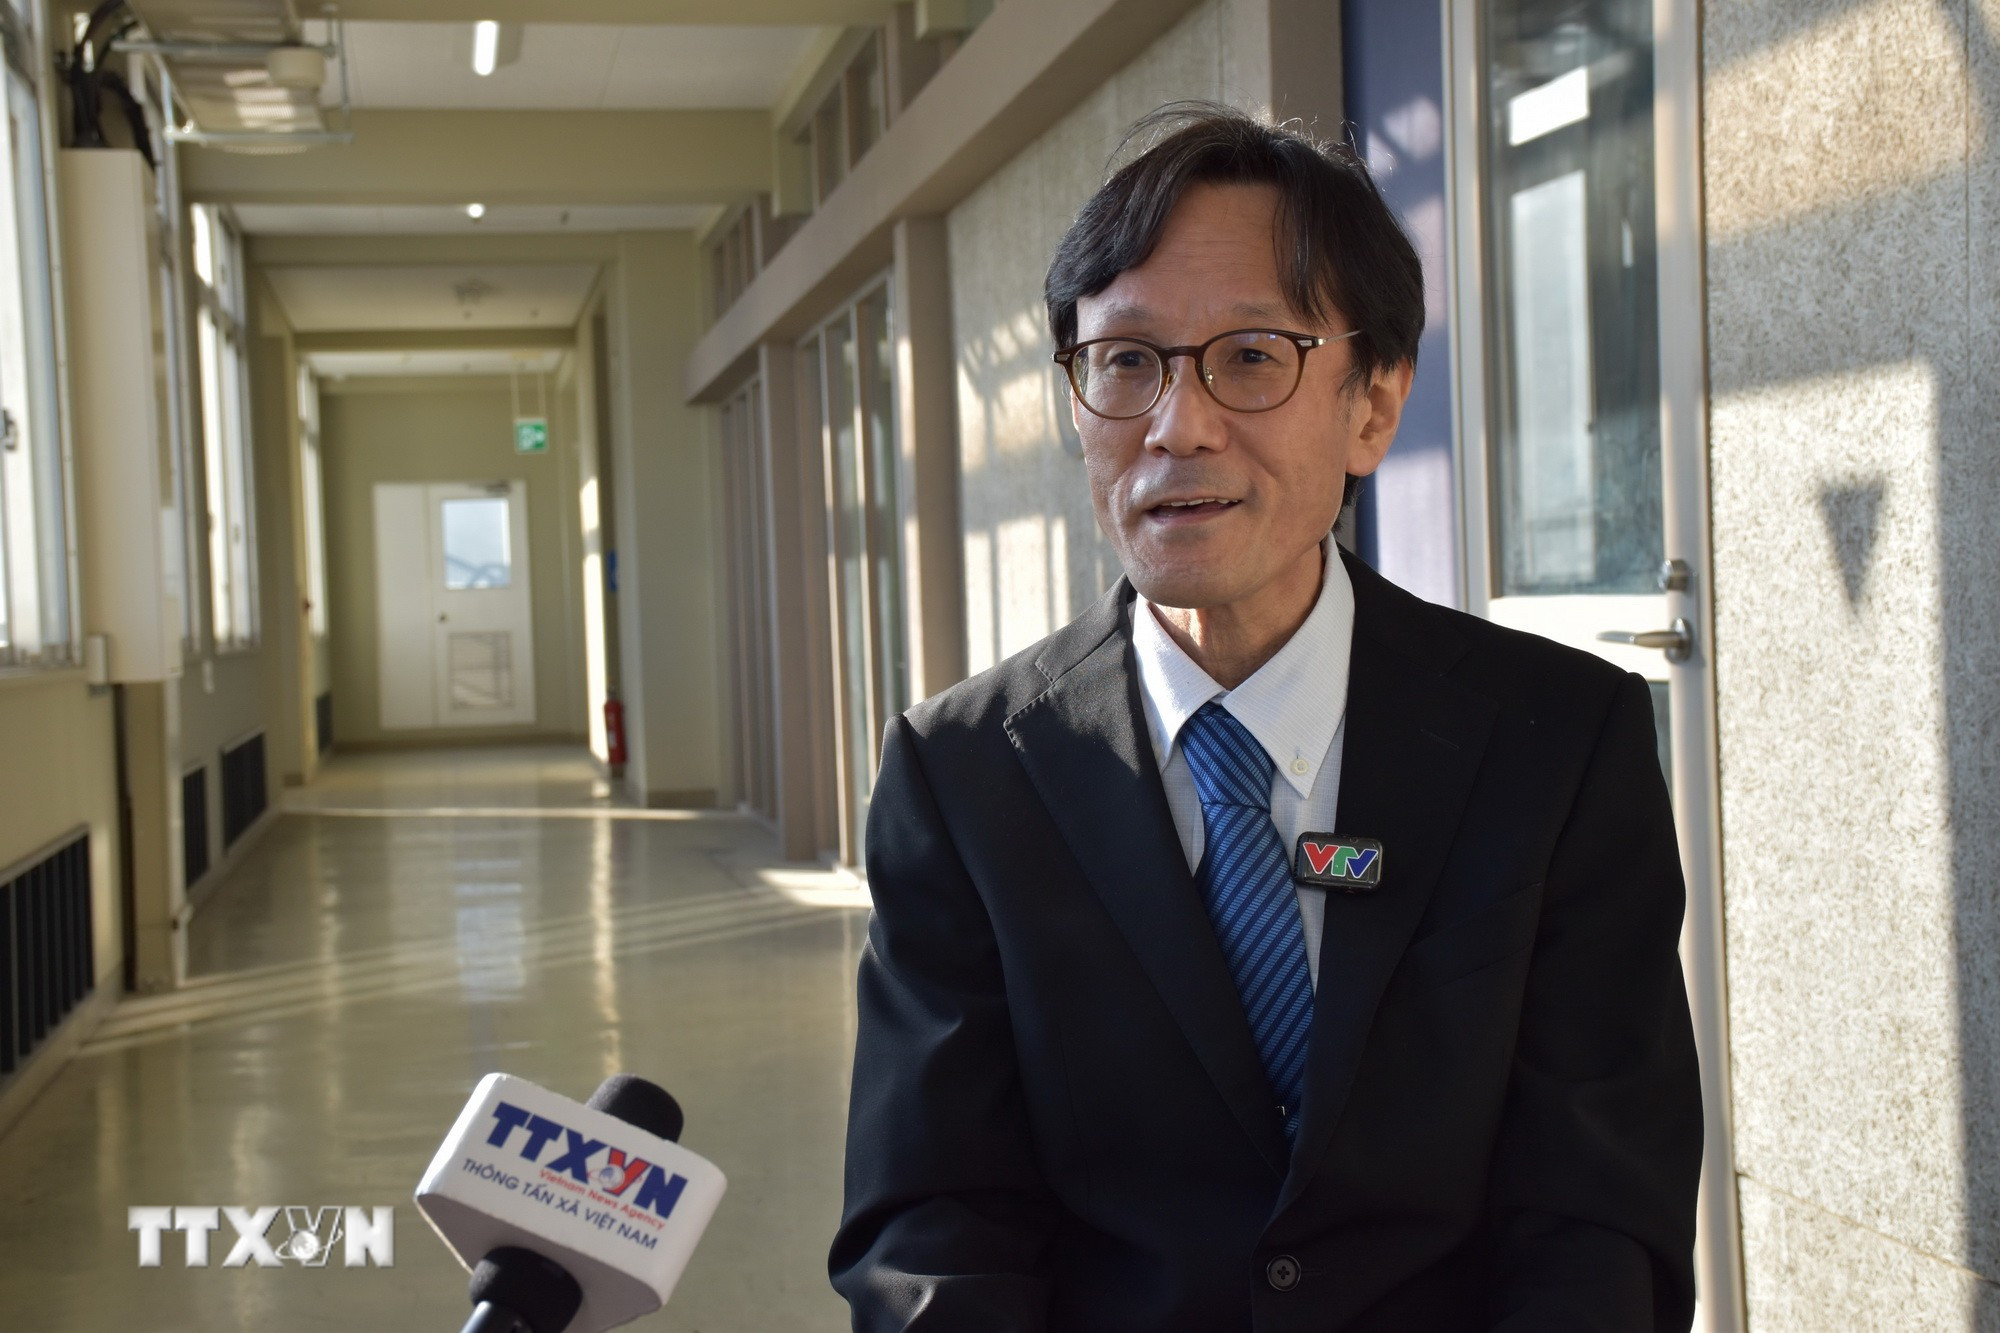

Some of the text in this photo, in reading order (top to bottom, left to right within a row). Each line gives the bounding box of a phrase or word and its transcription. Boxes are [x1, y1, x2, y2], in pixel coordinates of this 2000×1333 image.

[1302, 842, 1378, 878] VTV
[487, 1101, 688, 1219] TTXVN
[463, 1157, 519, 1190] THÔNG
[521, 1182, 554, 1205] TẤN
[585, 1207, 617, 1231] VIỆT
[617, 1222, 658, 1250] NAM
[539, 1169, 666, 1231] Vietnam News Agency
